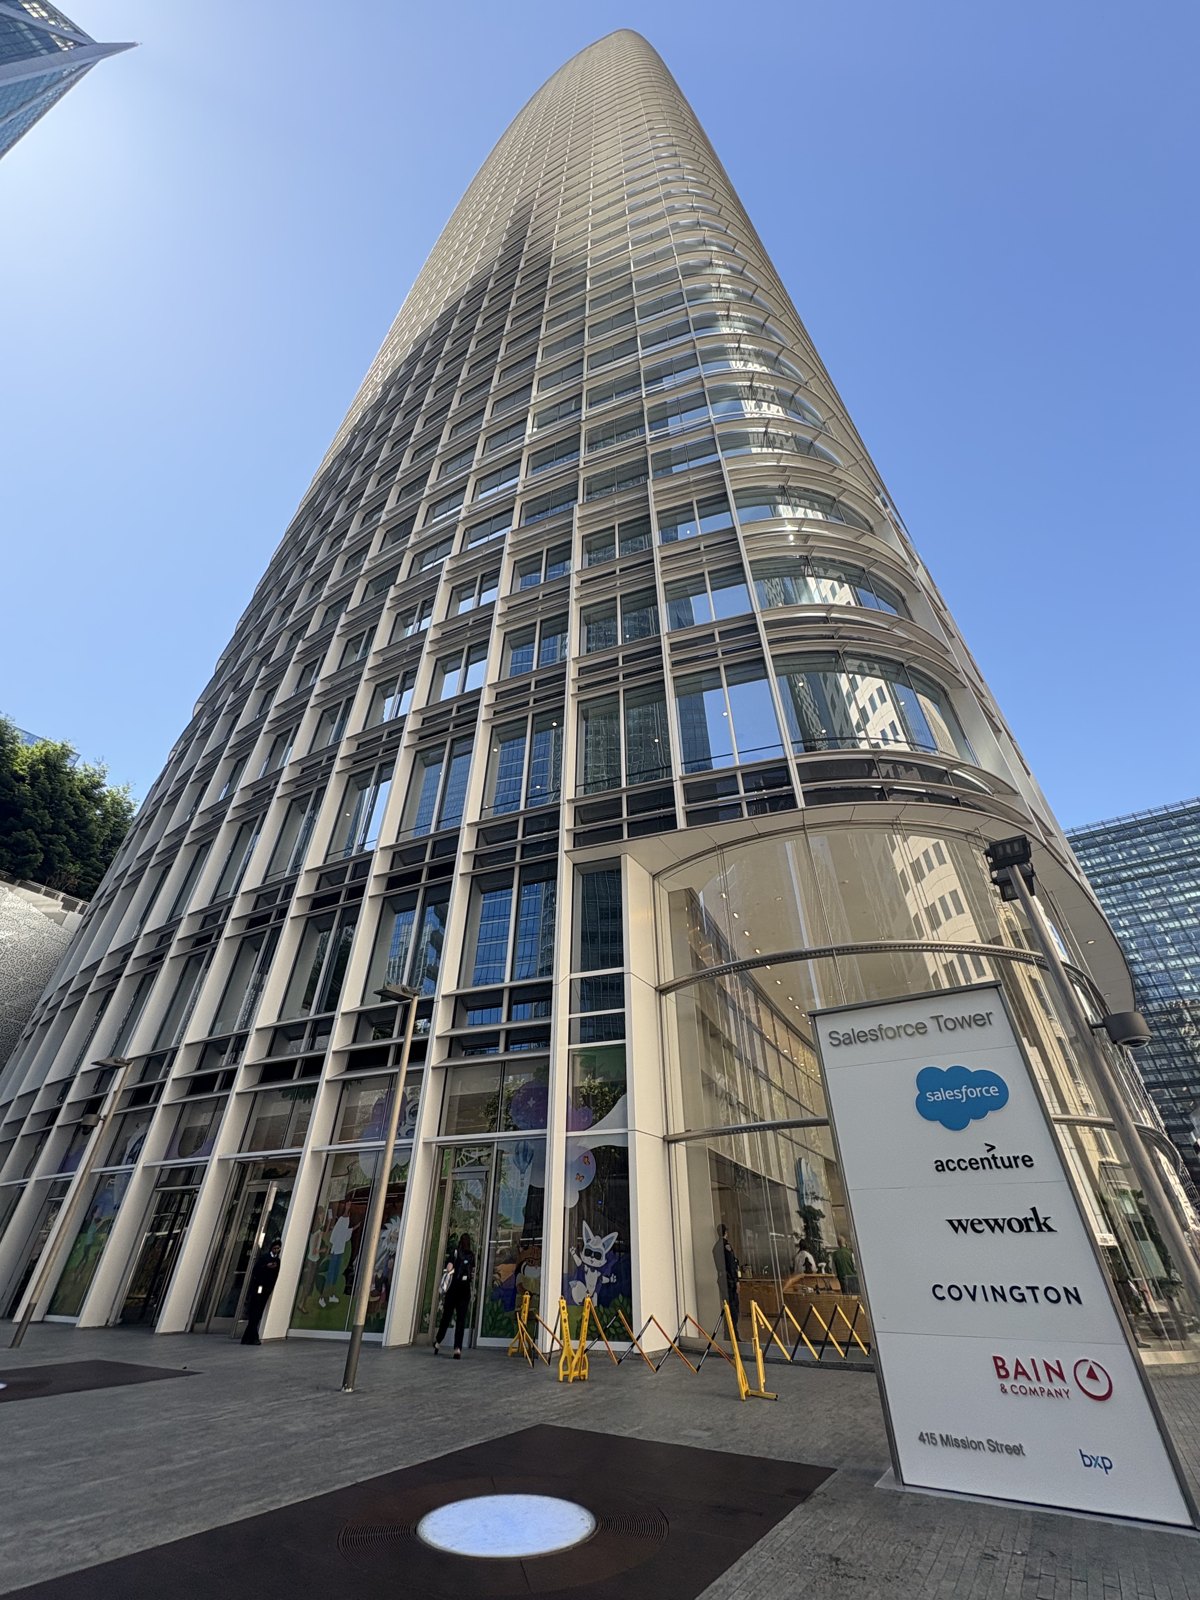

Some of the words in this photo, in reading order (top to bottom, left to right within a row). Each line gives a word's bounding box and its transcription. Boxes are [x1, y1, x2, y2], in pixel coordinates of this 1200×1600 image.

[828, 1019, 928, 1047] Salesforce
[930, 1010, 994, 1033] Tower
[926, 1083, 1000, 1103] salesforce
[934, 1152, 1034, 1173] accenture
[945, 1206, 1058, 1234] wework
[931, 1283, 1083, 1305] COVINGTON
[991, 1355, 1067, 1384] BAIN
[999, 1383, 1009, 1395] &
[1010, 1384, 1070, 1400] COMPANY
[917, 1431, 938, 1447] 415
[938, 1433, 986, 1453] Mission
[986, 1438, 1026, 1457] Street
[1078, 1448, 1114, 1475] bxp
